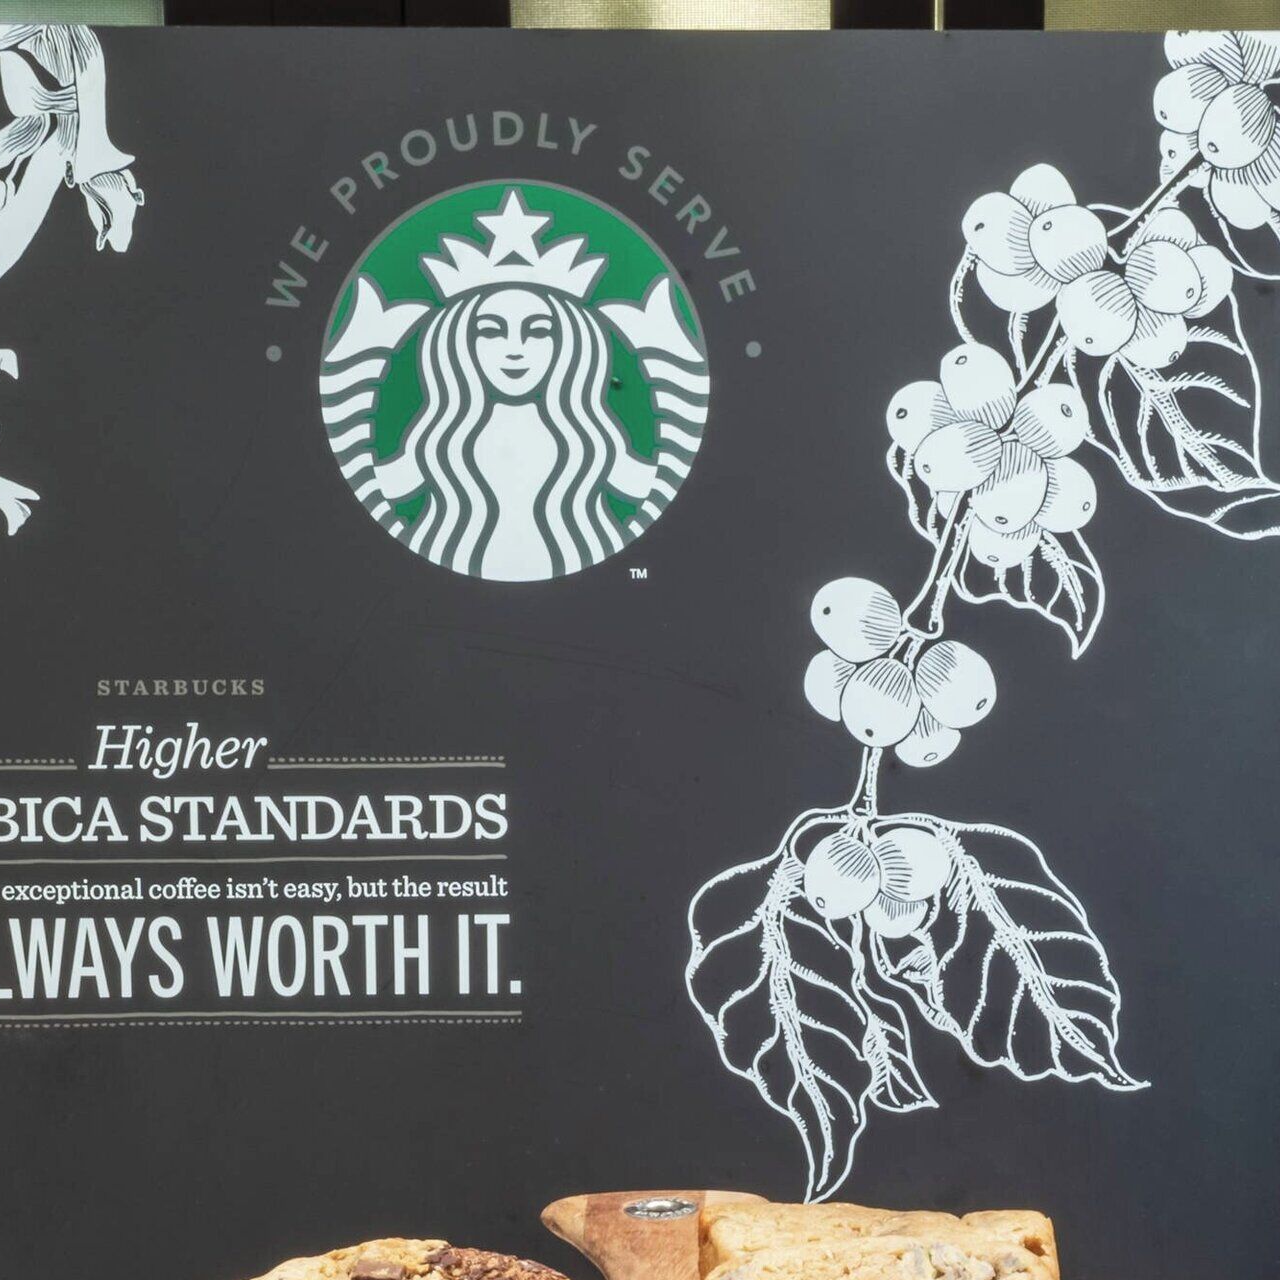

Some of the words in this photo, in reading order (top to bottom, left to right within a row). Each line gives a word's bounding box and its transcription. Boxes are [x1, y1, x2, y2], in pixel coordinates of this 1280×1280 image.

[265, 225, 329, 310] WE
[330, 110, 597, 215] PROUDLY
[619, 145, 757, 303] SERVE
[97, 679, 265, 696] STARBUCKS
[88, 722, 268, 780] Higher
[140, 793, 508, 842] STANDARDS
[1, 877, 144, 905] exceptional
[148, 877, 221, 901] coffee
[283, 881, 342, 903] easy,
[347, 875, 387, 899] but
[392, 875, 432, 898] the
[437, 874, 508, 897] result
[206, 914, 430, 997] WORTH
[458, 913, 522, 994] IT.
